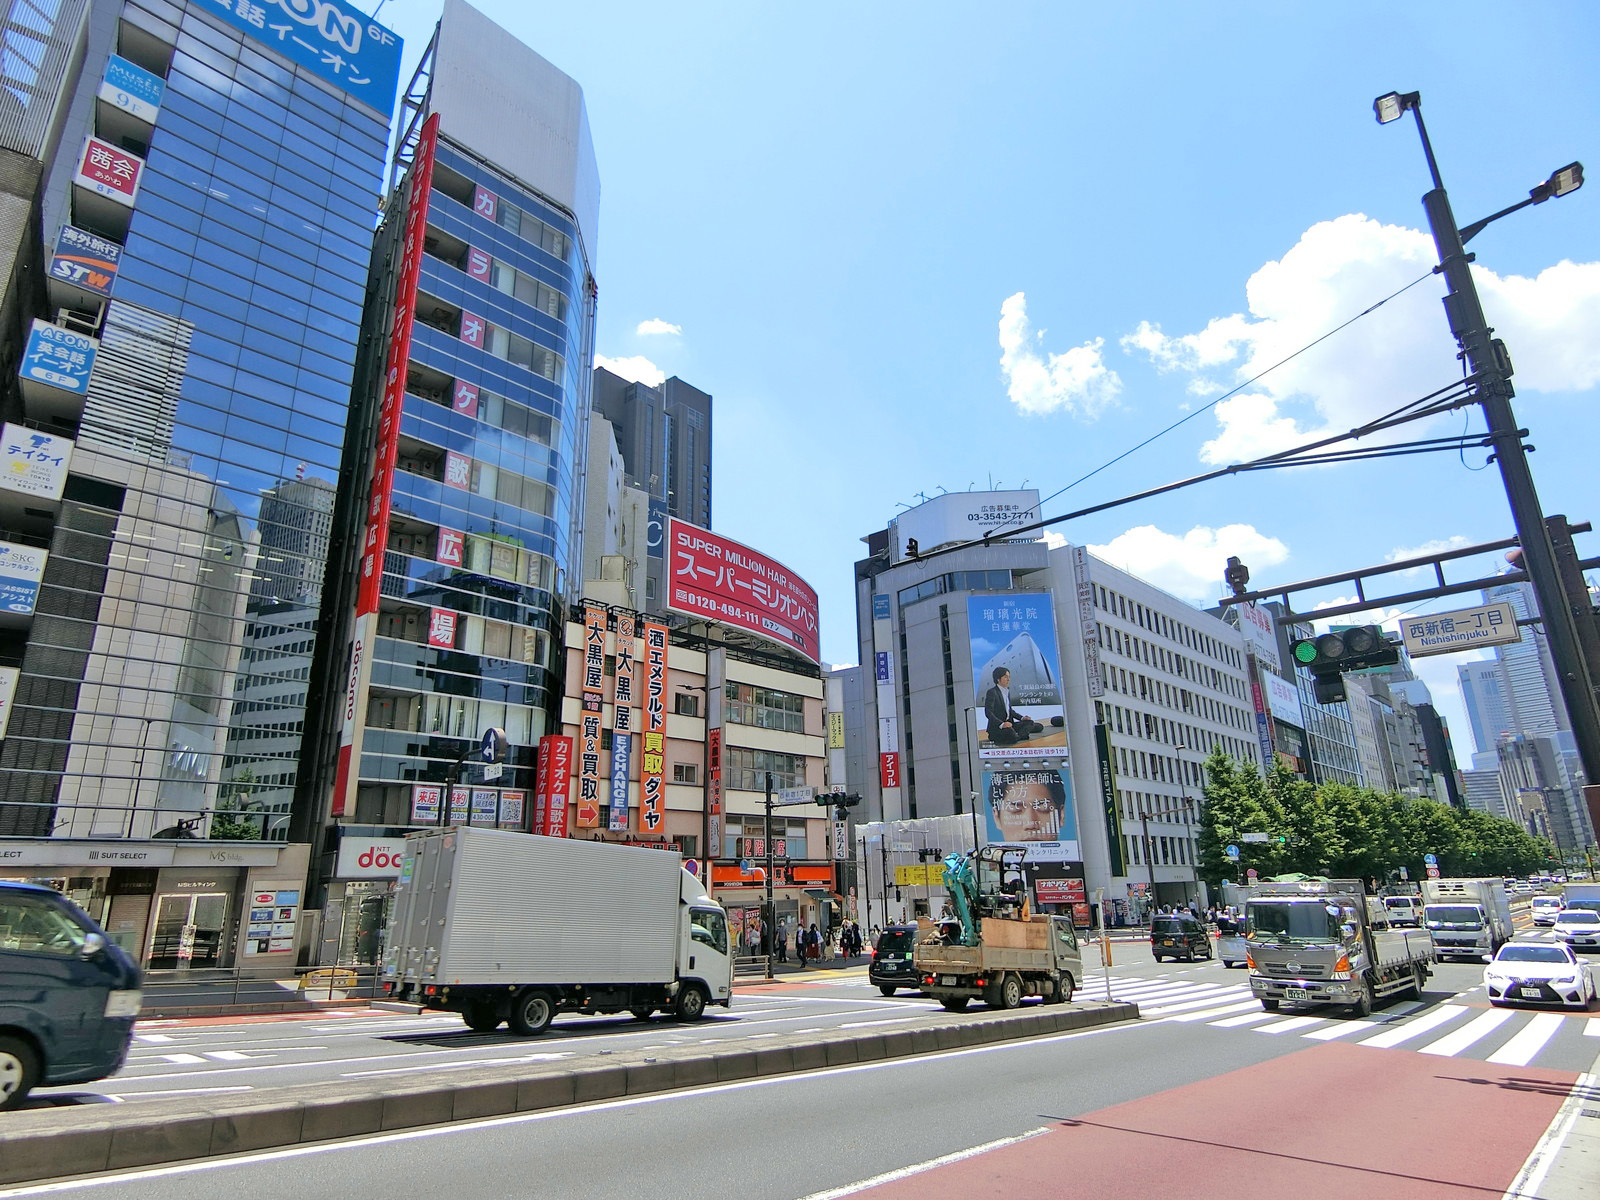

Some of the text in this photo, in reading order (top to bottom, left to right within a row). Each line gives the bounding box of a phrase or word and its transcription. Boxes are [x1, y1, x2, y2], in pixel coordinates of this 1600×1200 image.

[210, 0, 371, 84] 話イーオン
[367, 25, 396, 46] 6F
[116, 93, 142, 113] 9F
[89, 146, 135, 181] 茜会
[94, 170, 122, 187] あかね
[62, 228, 119, 257] 海外旅行
[40, 327, 90, 350] AEON
[29, 353, 88, 376] イーオン
[37, 340, 87, 366] 英会話
[8, 445, 64, 467] テイケイ
[967, 512, 1034, 521] 03-3543-7771
[12, 552, 35, 563] SKC
[677, 532, 787, 588] SUPER MILLION HAIR
[1, 592, 34, 604] アシスト
[676, 551, 818, 633] スーパーミリオンヘアー
[687, 593, 760, 625] 0120-494-111
[983, 607, 1038, 620] 瑠璃光院
[1409, 610, 1503, 638] 西新宿一丁目
[1421, 627, 1498, 646] Nishishinjuku 1
[586, 621, 605, 689] 大黒屋
[347, 640, 363, 720] docomo
[614, 648, 633, 730] 大黒屋
[647, 629, 666, 729] 酒エメラルド
[538, 741, 549, 793] カラオケ
[553, 741, 568, 793] カラオケ
[581, 716, 600, 801] 質&買取
[643, 731, 664, 775] 買取
[614, 735, 628, 808] EXCHANGE
[885, 754, 896, 787] アイフル
[990, 773, 1064, 785] 薄毛は医師に、
[417, 790, 438, 804] 来店
[645, 777, 661, 830] ダイヤ
[992, 786, 1028, 798] という方
[992, 798, 1054, 811] 増えています。
[209, 851, 226, 861] MS
